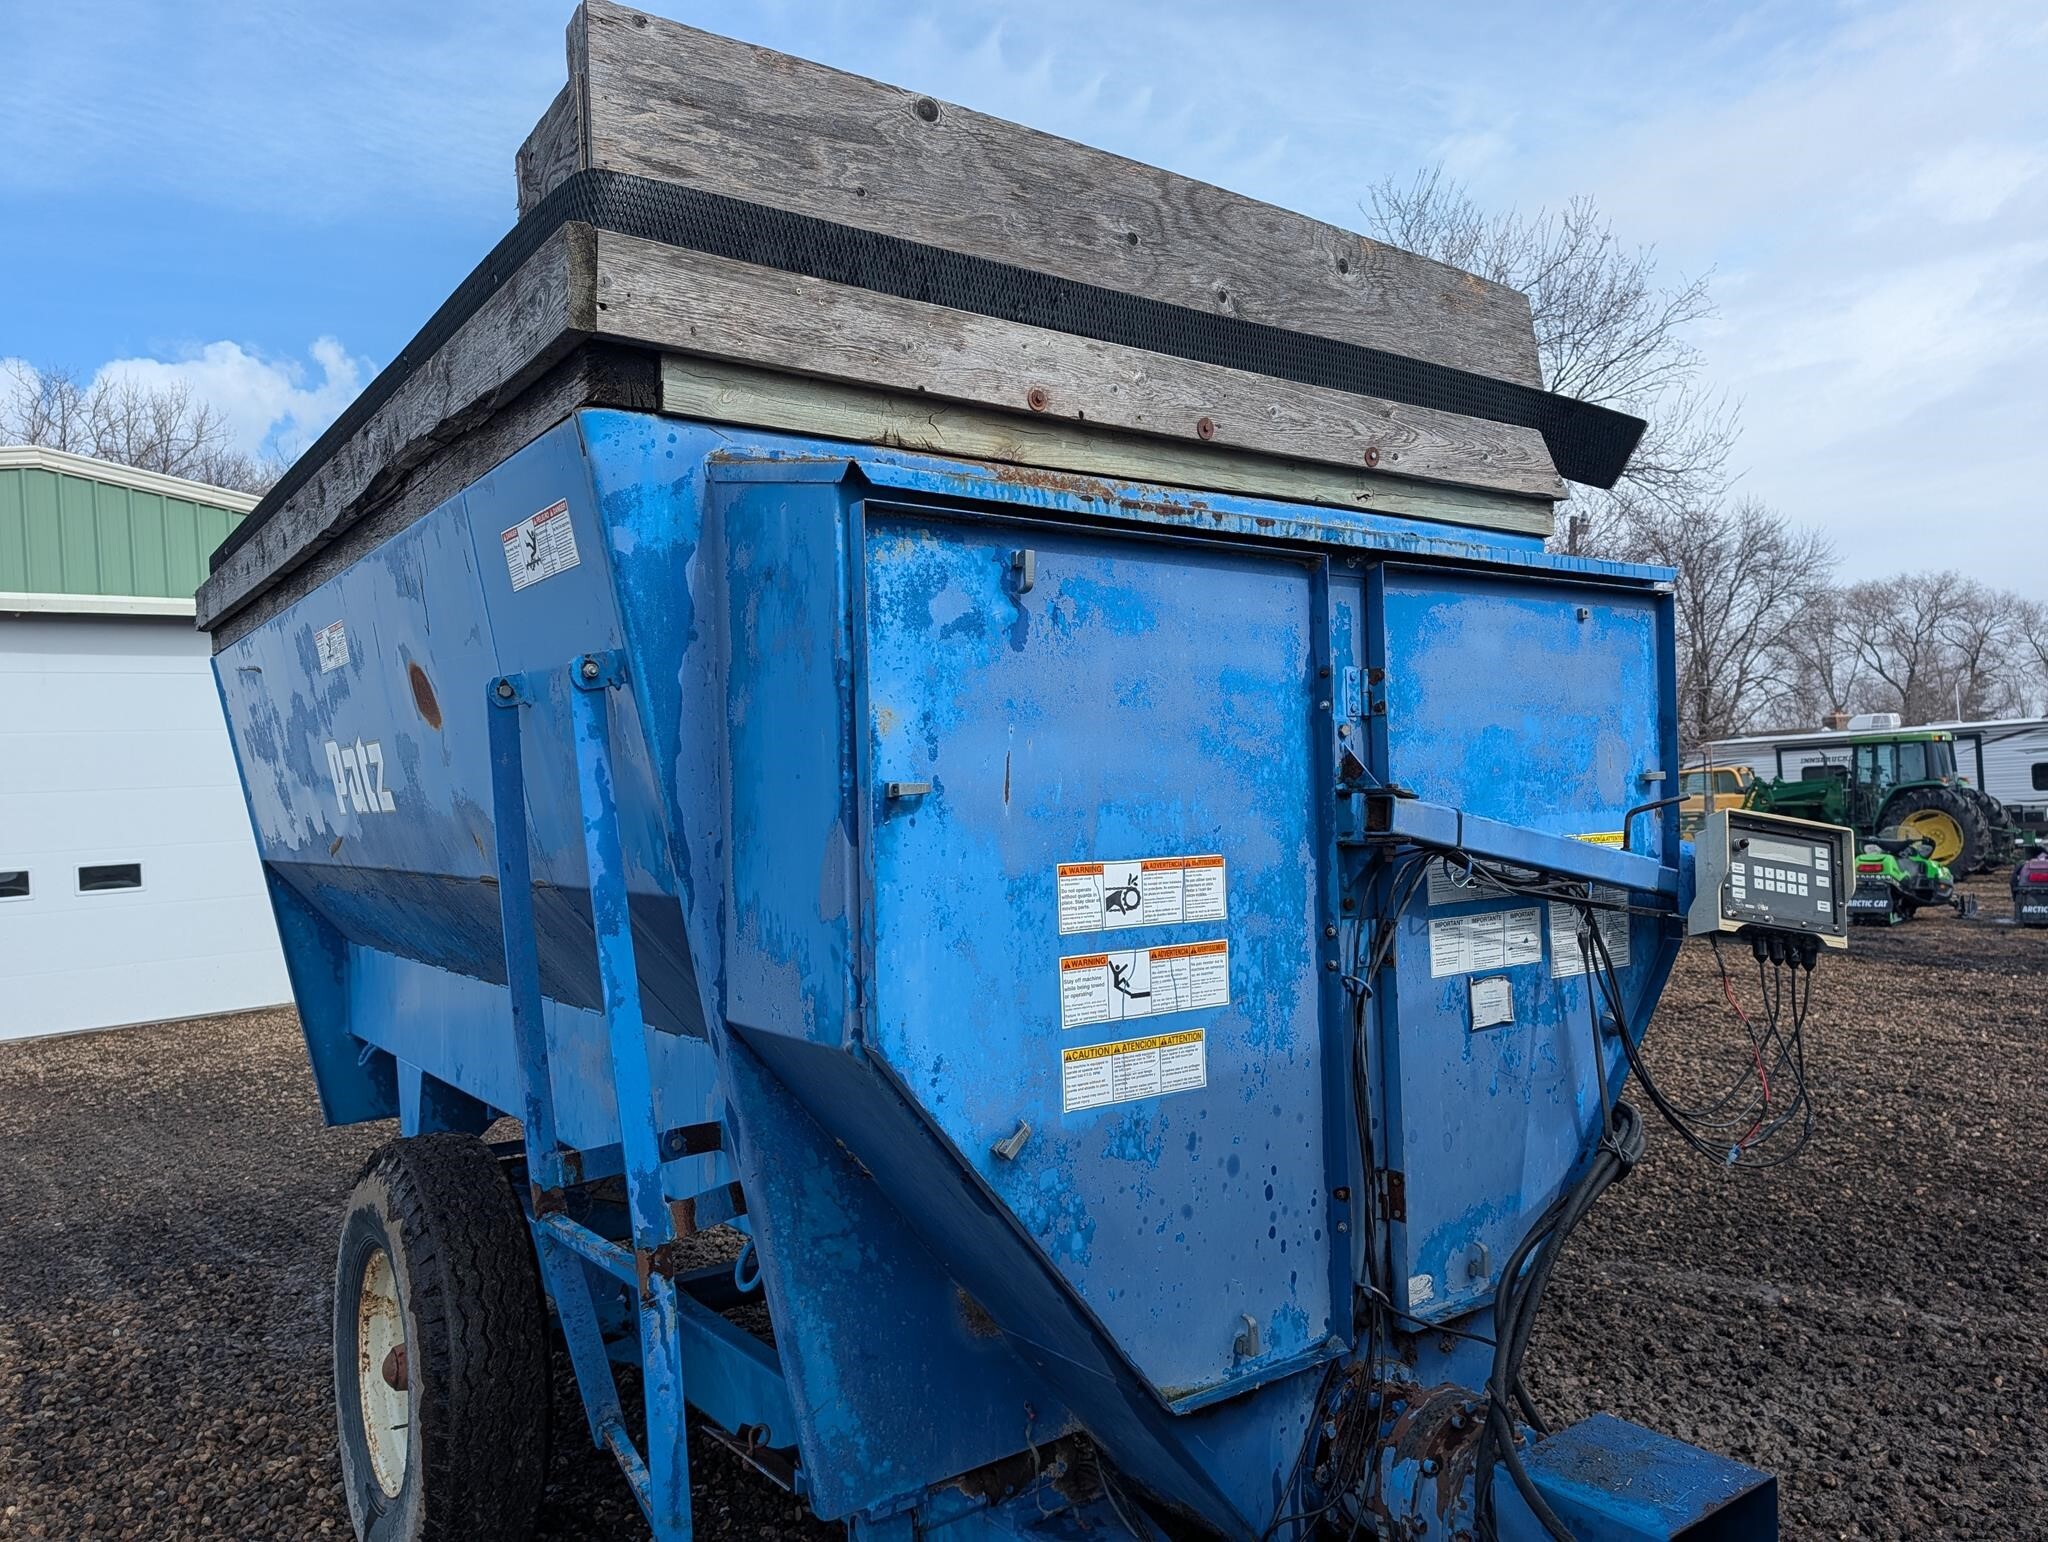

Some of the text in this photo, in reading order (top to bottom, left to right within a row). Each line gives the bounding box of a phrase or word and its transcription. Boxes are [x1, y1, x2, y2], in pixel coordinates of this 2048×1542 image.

[324, 735, 397, 816] Patz
[1069, 866, 1102, 874] WARNING
[1874, 900, 1888, 908] CAT
[2022, 905, 2048, 913] ARCTIC
[1510, 910, 1536, 919] IMPORTANT
[1435, 920, 1464, 928] IMPORTANT
[1472, 915, 1502, 924] IMPORTANTE
[1158, 948, 1189, 957] ADVERTENCIA
[1071, 957, 1106, 967] WARNING
[1168, 1032, 1202, 1044] ATTENTION
[1122, 1039, 1157, 1052] ATENCION
[1072, 1046, 1110, 1060] CAUTION
